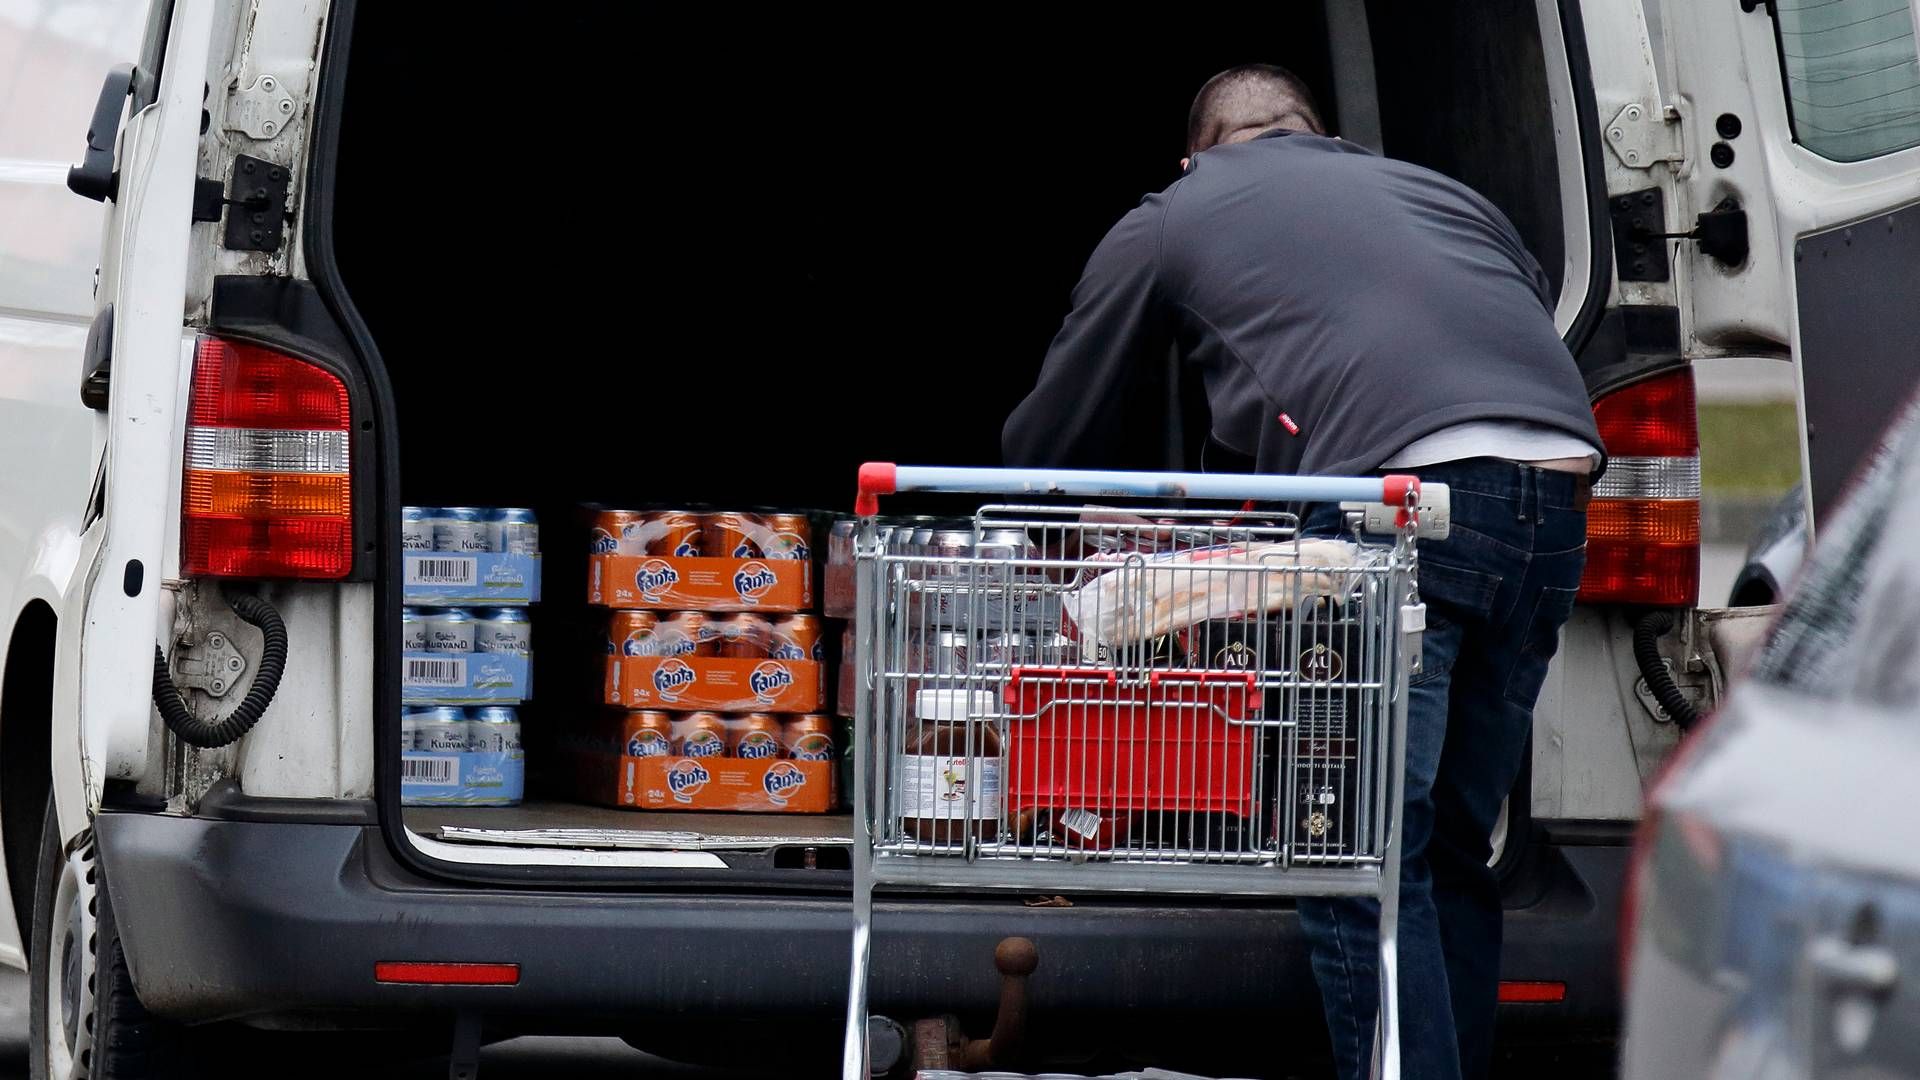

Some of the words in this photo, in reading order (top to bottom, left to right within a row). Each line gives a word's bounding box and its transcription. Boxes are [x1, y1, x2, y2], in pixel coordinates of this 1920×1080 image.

[403, 540, 431, 549] RVAND
[635, 567, 678, 592] Fanta
[734, 569, 776, 594] Fanta
[1226, 654, 1249, 666] AU
[1308, 655, 1331, 669] AU
[653, 667, 695, 691] Fanta
[750, 669, 792, 693] Fanta
[668, 766, 709, 791] Fanta
[764, 769, 806, 794] Fanta
